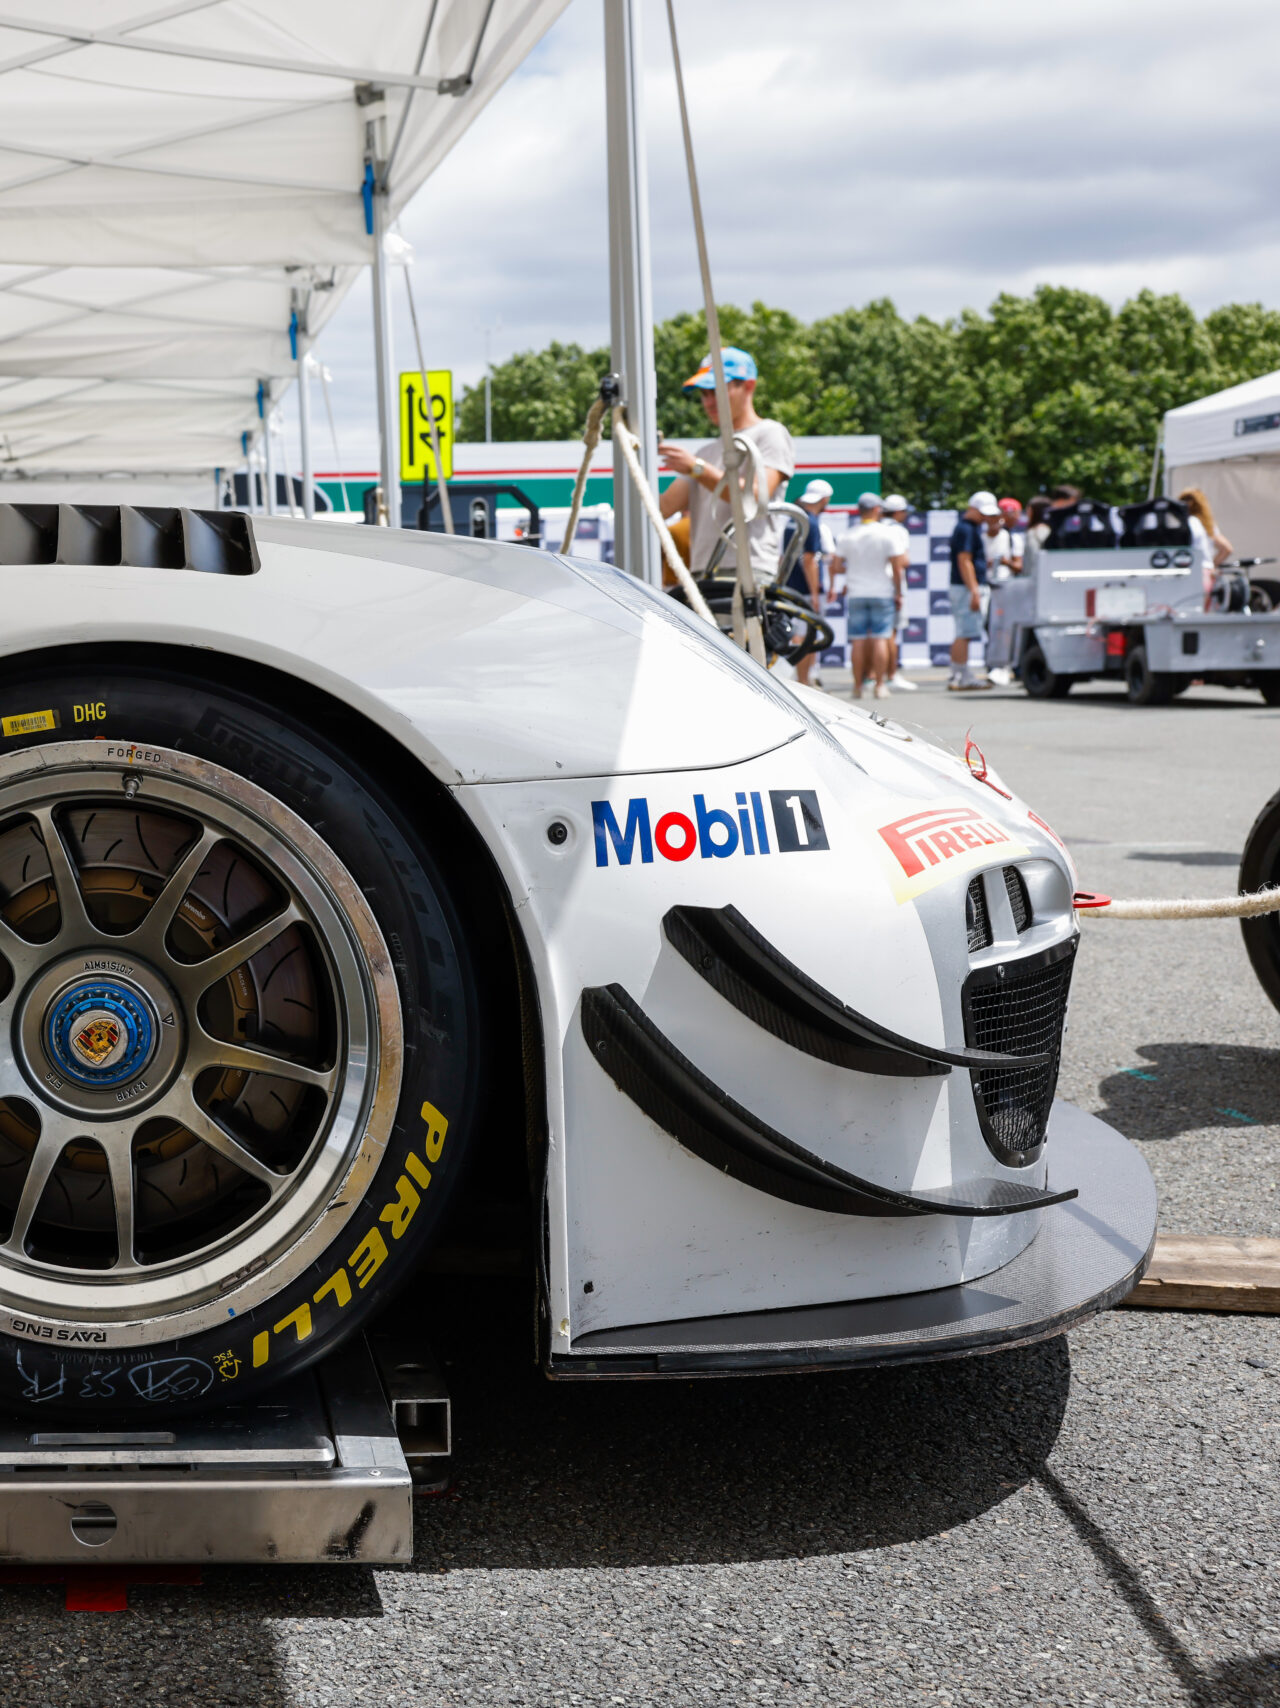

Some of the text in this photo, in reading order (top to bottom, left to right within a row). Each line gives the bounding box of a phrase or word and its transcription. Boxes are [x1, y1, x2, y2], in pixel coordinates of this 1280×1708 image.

[419, 394, 446, 456] 46
[73, 702, 107, 723] DHG
[107, 747, 162, 763] FORGED
[591, 792, 809, 867] Mobil 1
[876, 807, 1011, 878] PIRELLI
[253, 1101, 449, 1368] PIRELLI
[10, 1318, 107, 1343] RAYS ENG.
[212, 1349, 234, 1364] FSC
